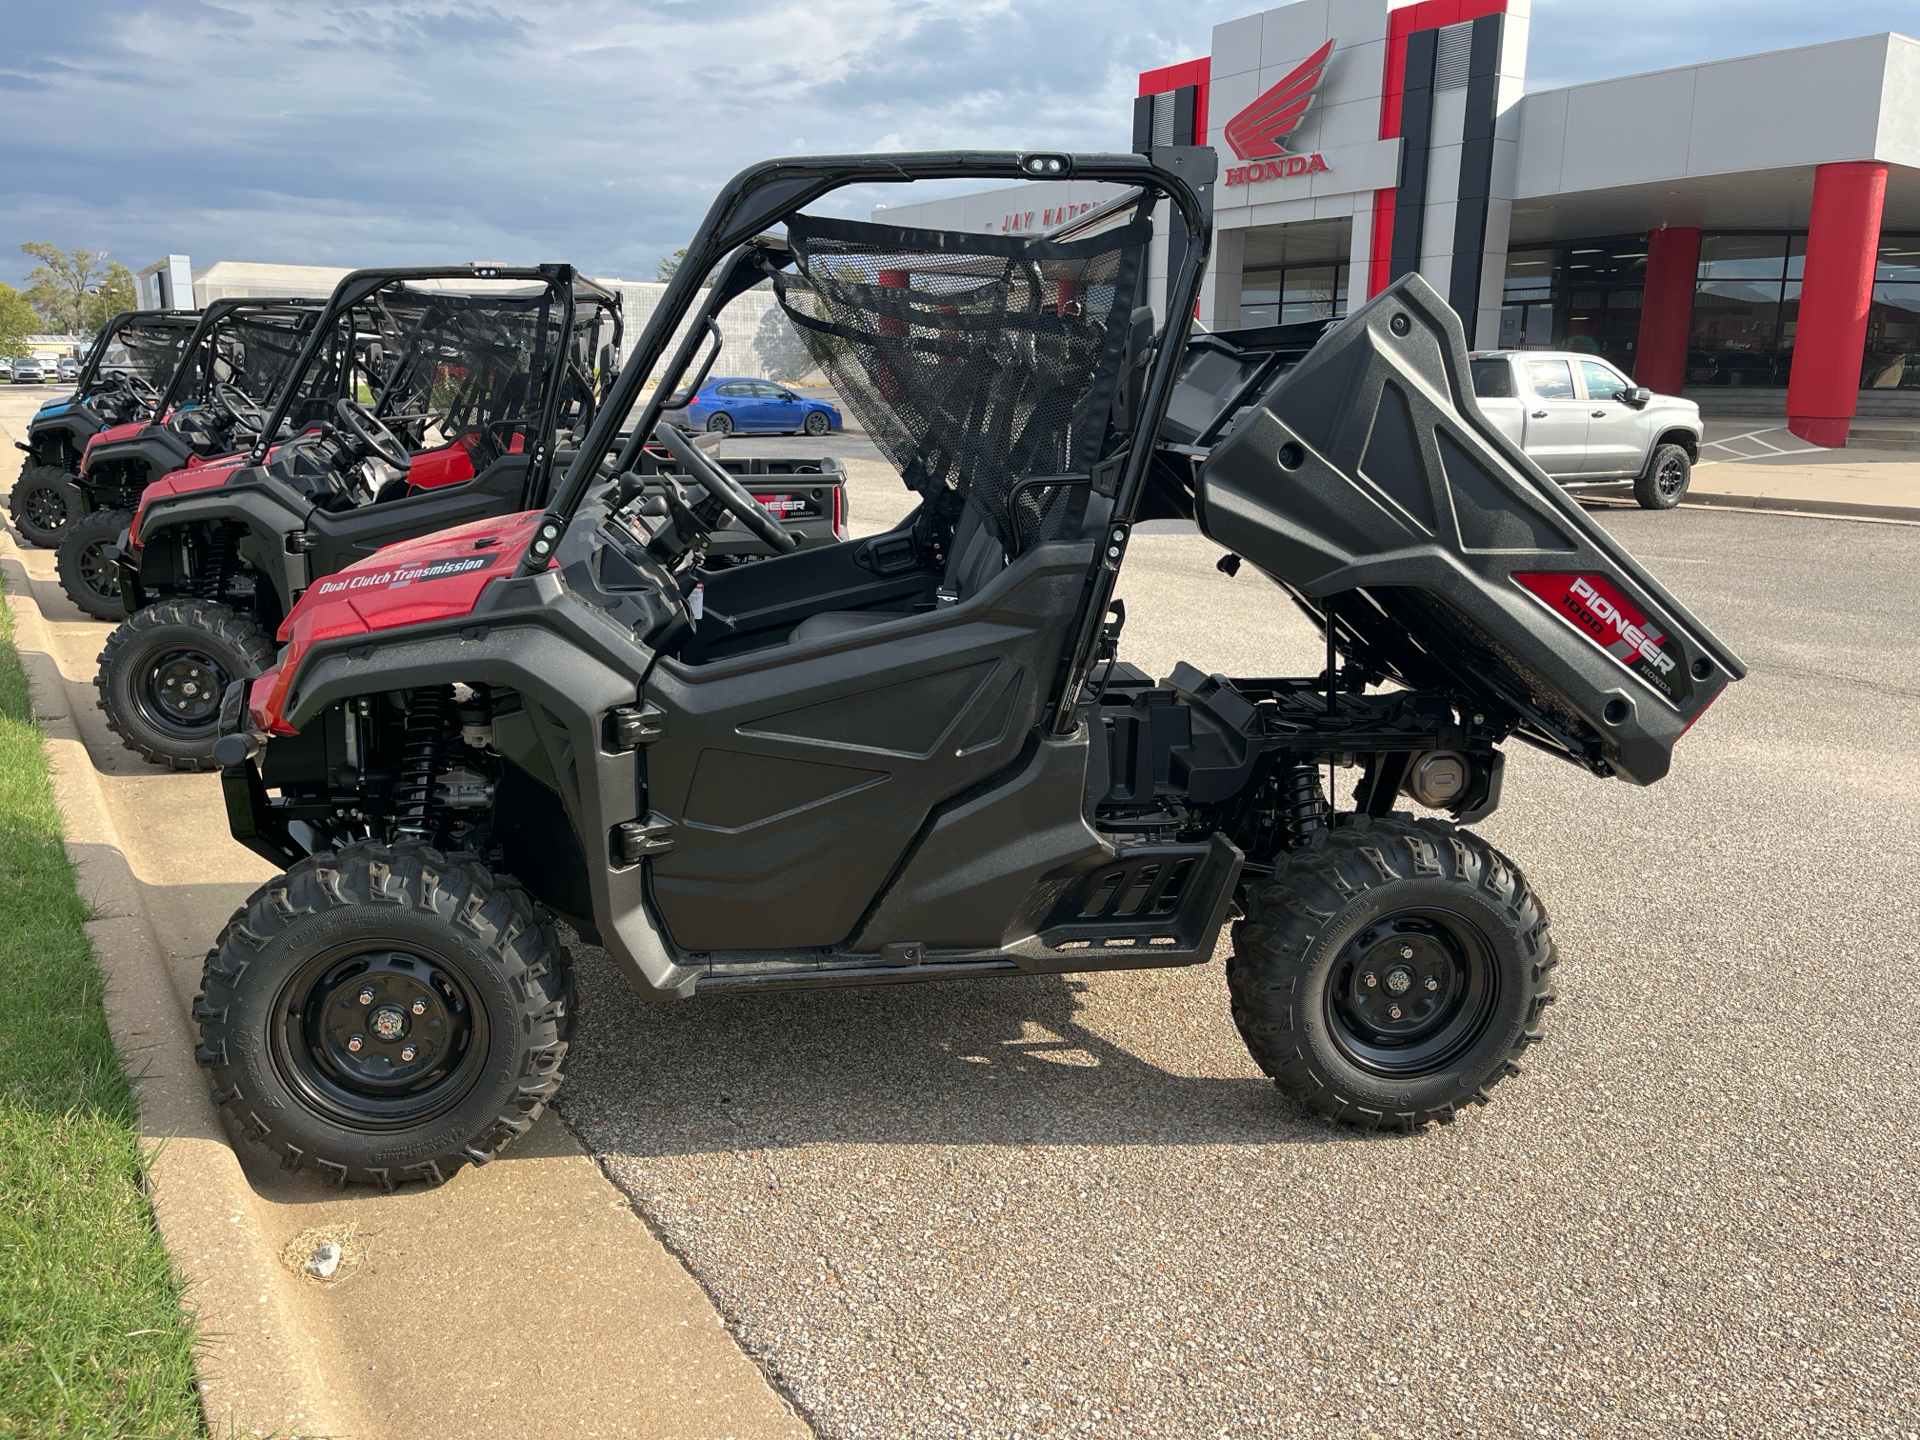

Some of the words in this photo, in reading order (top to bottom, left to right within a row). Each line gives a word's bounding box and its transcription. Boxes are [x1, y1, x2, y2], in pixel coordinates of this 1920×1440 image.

[1225, 153, 1329, 186] HONDA
[1001, 210, 1032, 231] JAY
[1043, 200, 1108, 226] HATF
[318, 579, 350, 595] Dual
[349, 572, 392, 589] Clutch
[393, 559, 484, 581] Transmission
[1562, 593, 1605, 635] 1000
[1569, 577, 1676, 676] PIONEER
[1640, 664, 1672, 696] HONDA
